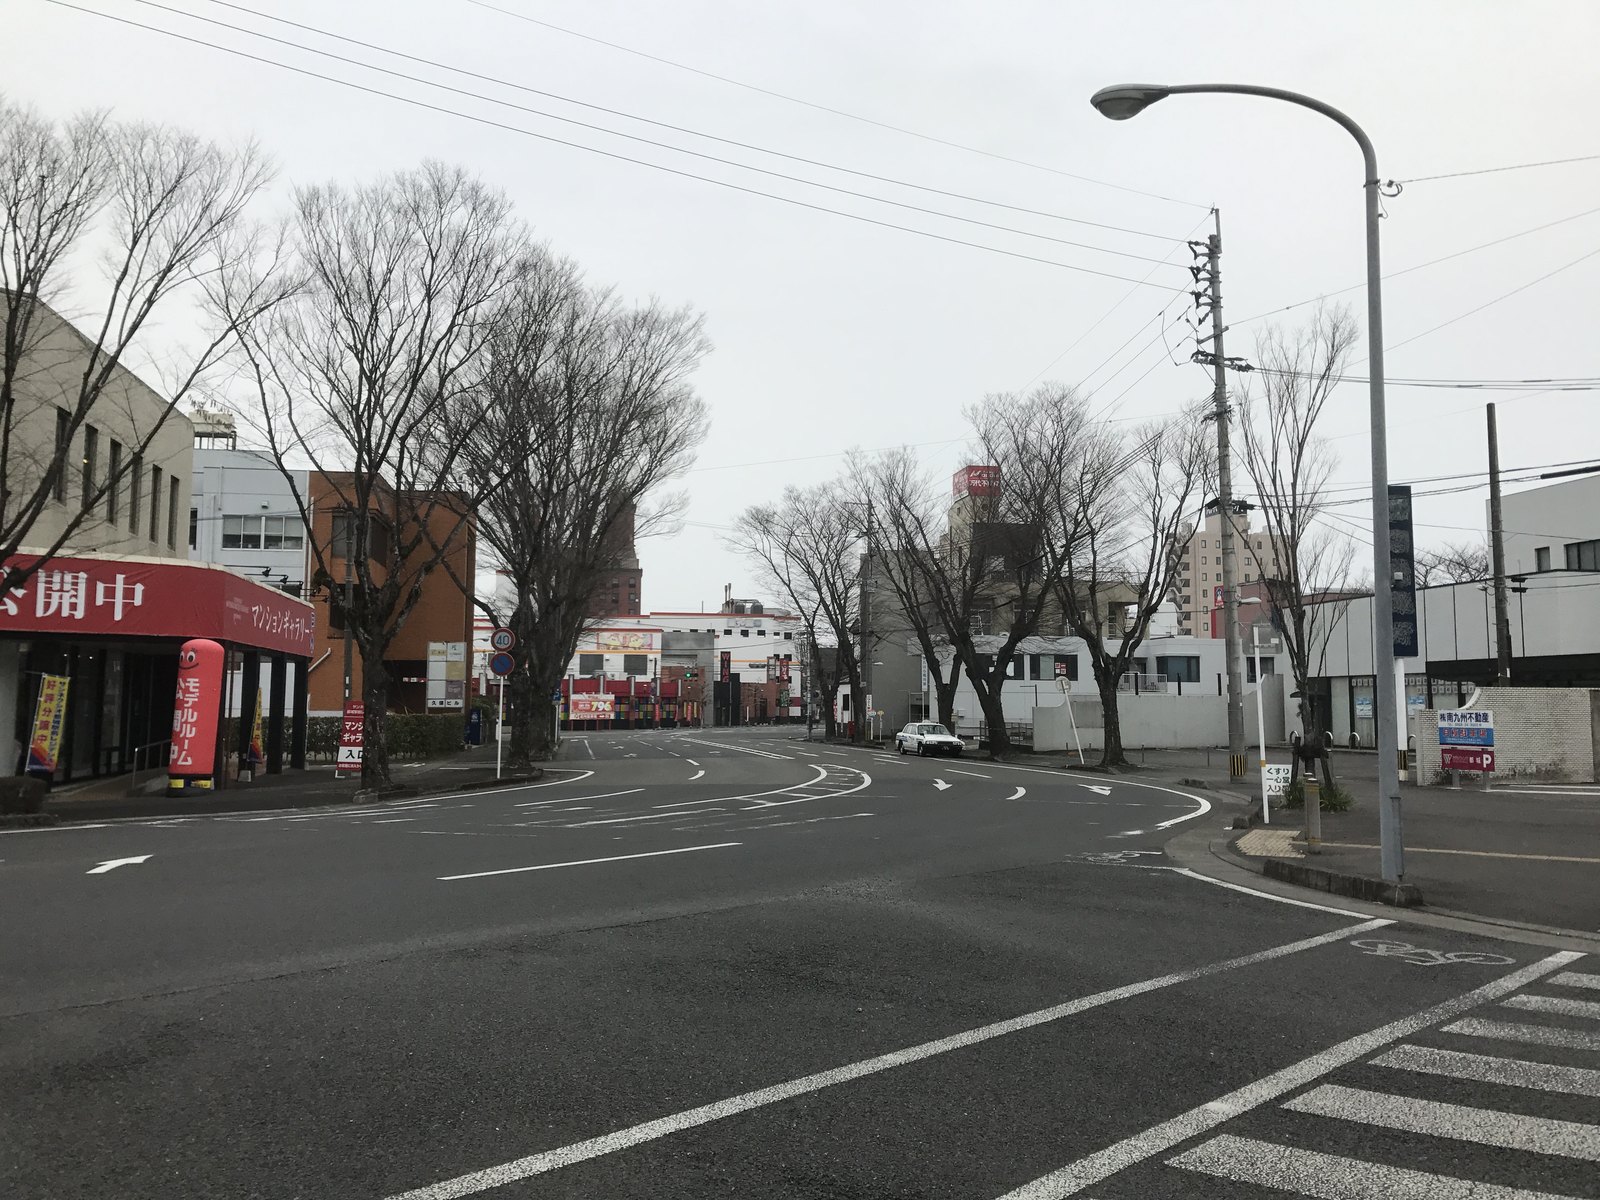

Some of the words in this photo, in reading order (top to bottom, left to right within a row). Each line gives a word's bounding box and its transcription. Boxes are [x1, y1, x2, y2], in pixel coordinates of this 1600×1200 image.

[251, 604, 310, 642] マンションギャラリー
[496, 634, 510, 646] 40
[721, 652, 730, 683] WING
[591, 701, 612, 711] 796
[177, 678, 200, 766] モデルルーム
[1483, 754, 1492, 769] P
[1266, 767, 1290, 775] くすり
